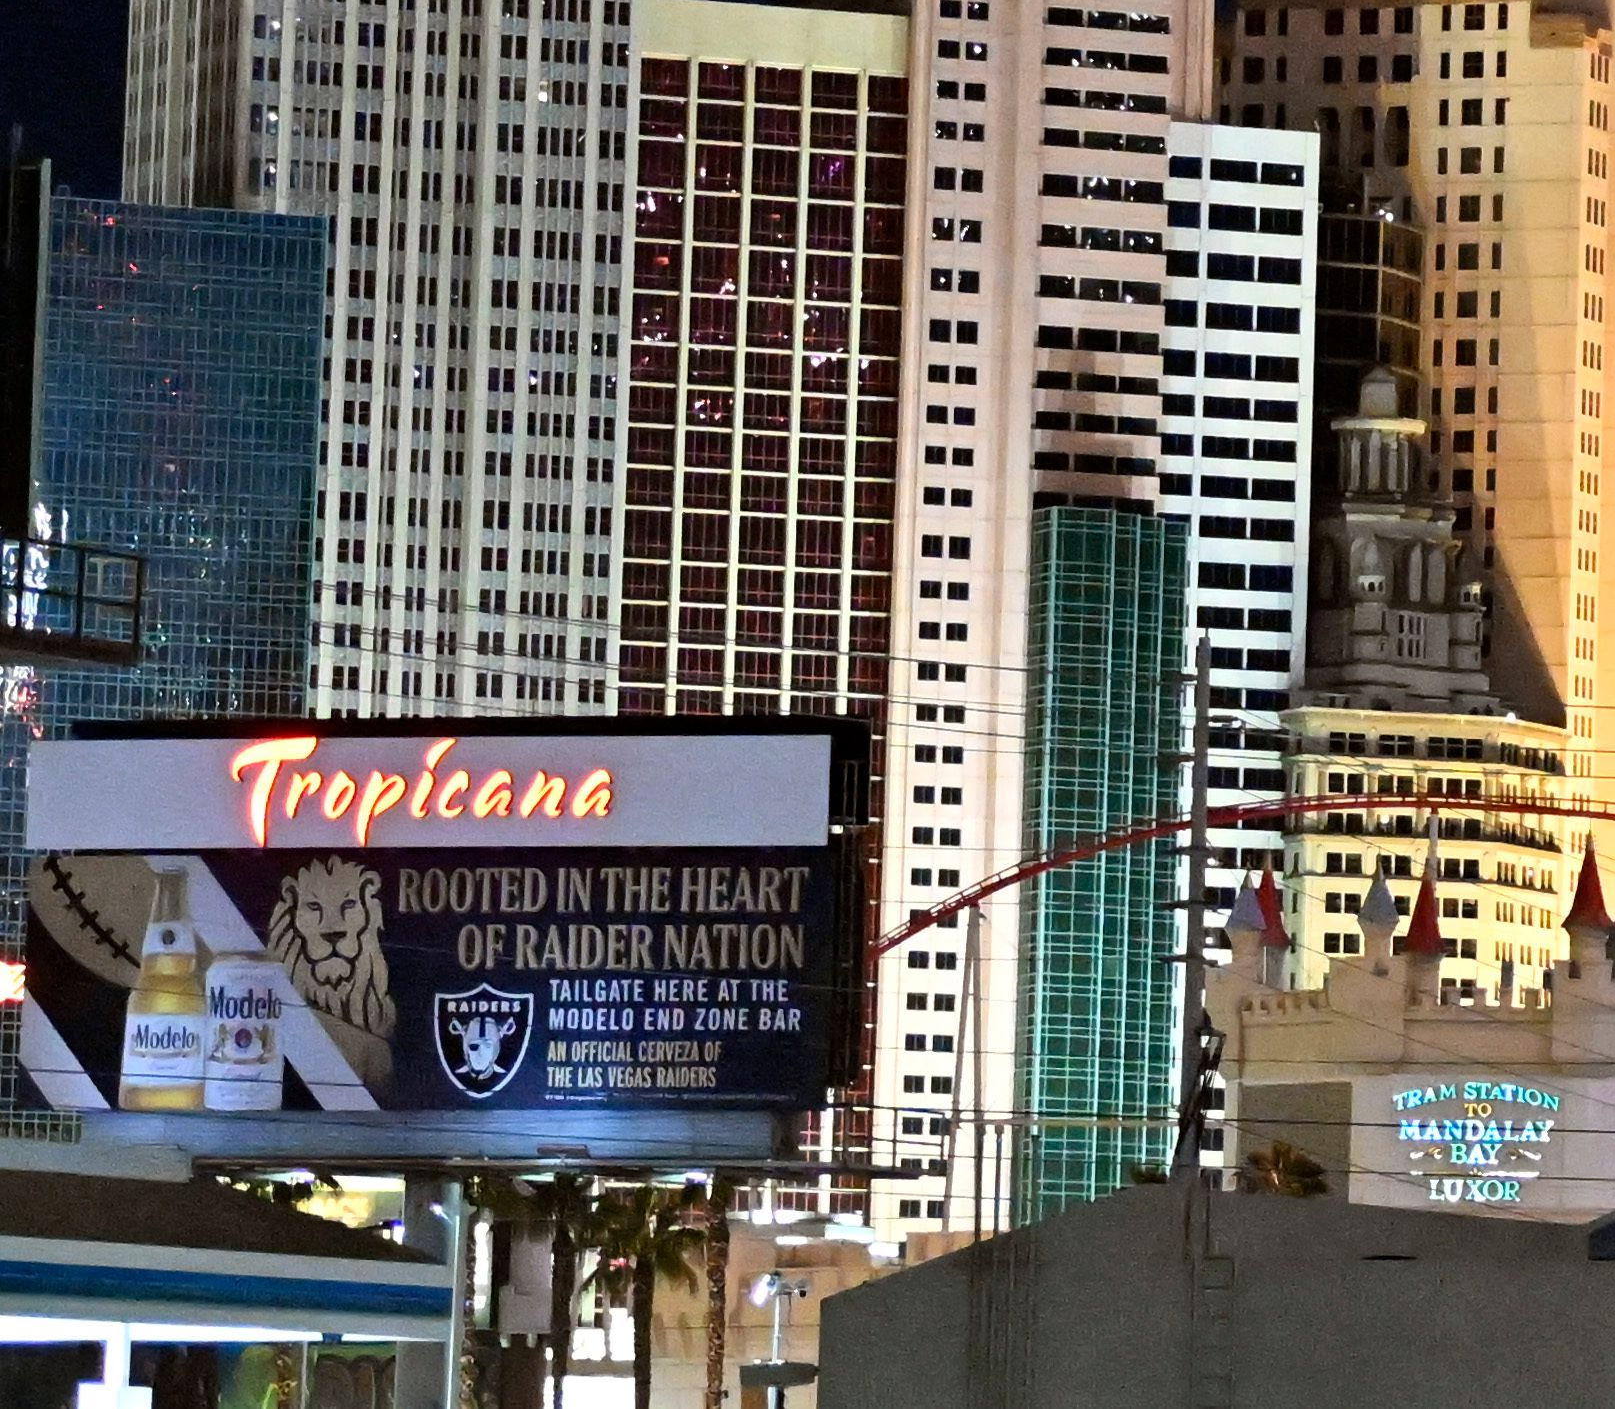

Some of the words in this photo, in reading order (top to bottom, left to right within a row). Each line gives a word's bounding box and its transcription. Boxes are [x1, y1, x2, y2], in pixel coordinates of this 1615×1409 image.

[229, 735, 613, 848] Tropicana
[398, 867, 549, 914] ROOTED
[555, 867, 594, 914] IN
[600, 867, 671, 914] THE
[680, 866, 810, 914] HEART
[457, 923, 507, 972] OF
[514, 923, 655, 972] RAIDER
[663, 923, 806, 972] NATION
[209, 986, 283, 1020] Modelo
[549, 979, 645, 1003] TAILGATE
[653, 979, 709, 1003] HERE
[717, 979, 739, 1003] AT
[751, 979, 789, 1003] THE
[447, 1000, 522, 1014] RAIDERS
[548, 1008, 635, 1031] MODELO
[643, 1008, 685, 1031] END
[694, 1008, 750, 1031] ZONE
[758, 1008, 801, 1031] BAR
[135, 1024, 195, 1050] Modelo
[547, 1041, 567, 1063] AN
[571, 1041, 634, 1063] OFFICIAL
[638, 1041, 700, 1063] CERVEZA
[704, 1041, 723, 1063] OF
[547, 1066, 573, 1089] THE
[577, 1066, 602, 1089] LAS
[607, 1066, 652, 1089] VEGAS
[656, 1066, 718, 1089] RAIDERS
[1392, 1083, 1457, 1112] TRAM
[1463, 1081, 1561, 1112] STATION
[1464, 1102, 1493, 1118] TO
[1398, 1119, 1555, 1143] MANDALAY
[1450, 1143, 1502, 1165] BAY
[1429, 1179, 1521, 1203] LUXOR
